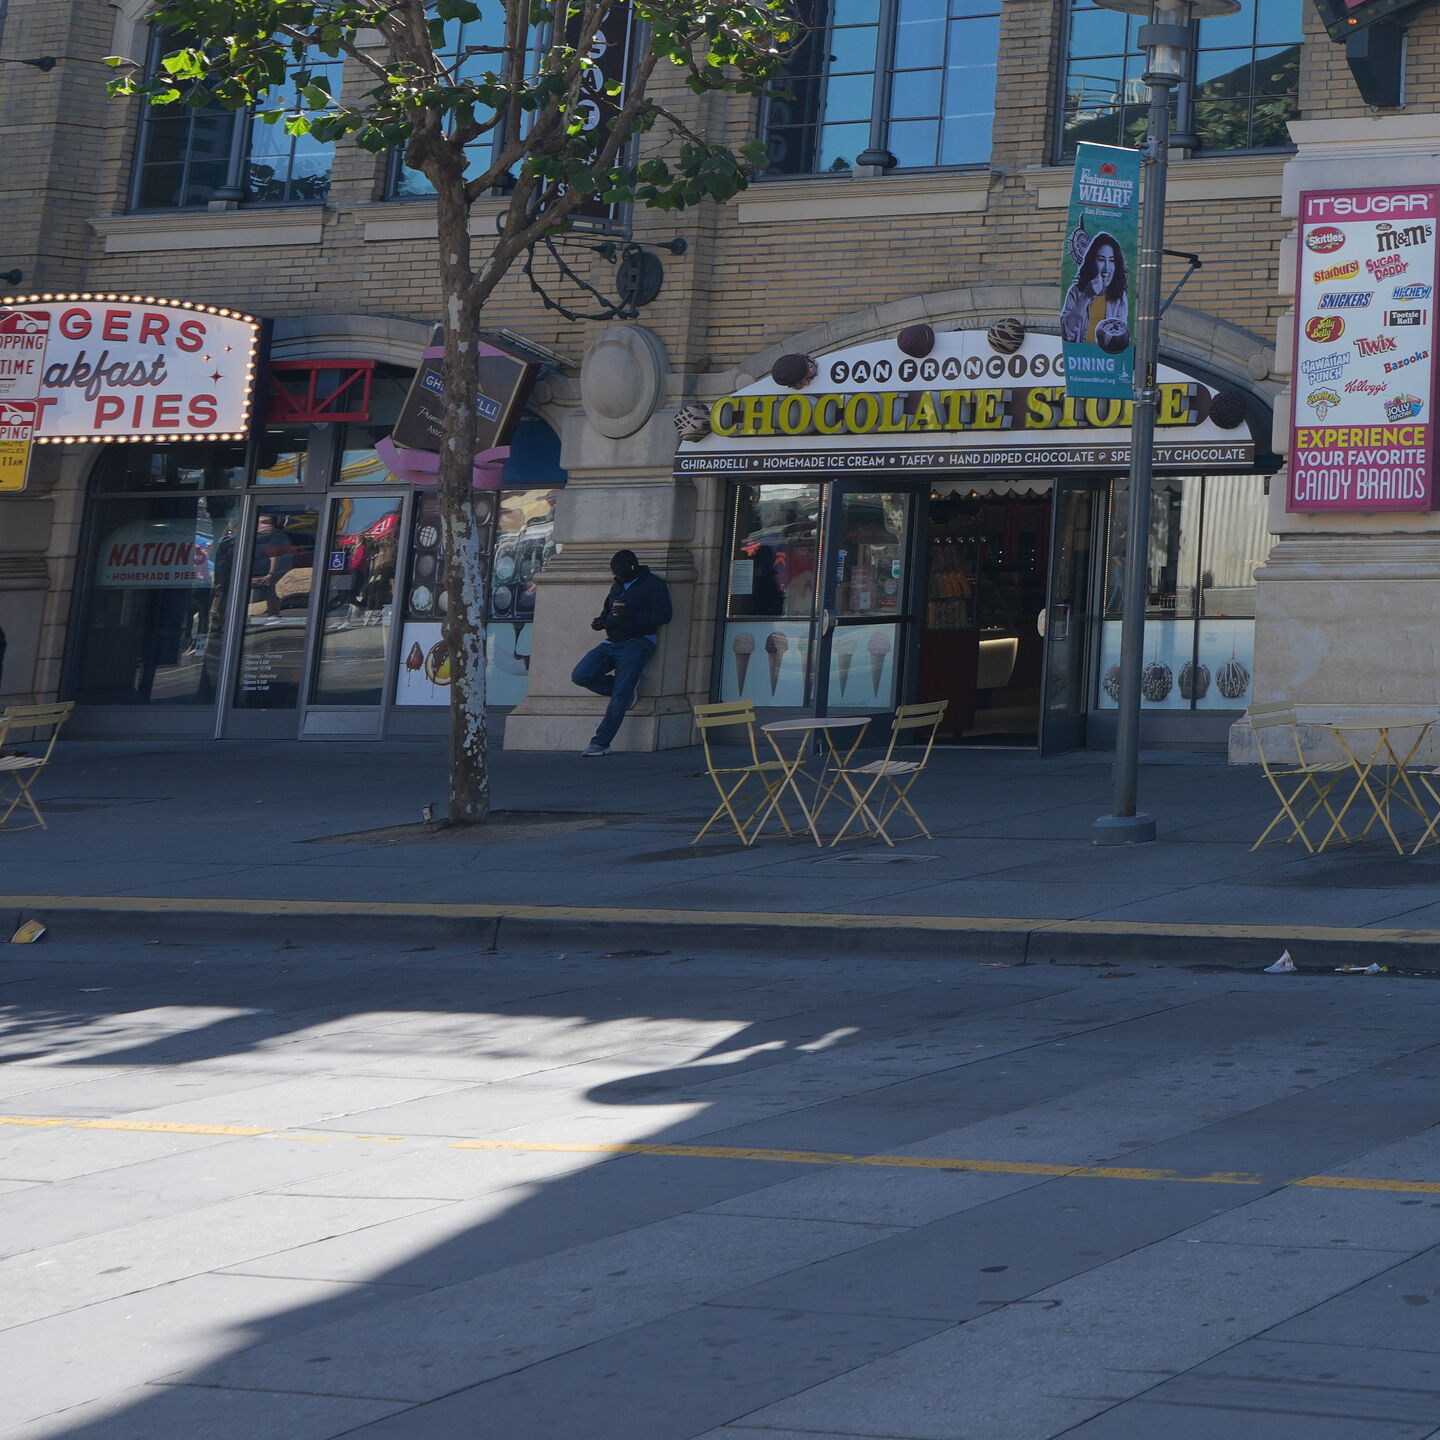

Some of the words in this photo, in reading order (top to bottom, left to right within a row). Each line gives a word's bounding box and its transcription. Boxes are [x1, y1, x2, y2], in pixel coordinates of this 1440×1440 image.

[1080, 168, 1133, 189] Fisherman's
[1079, 184, 1133, 208] WHARF
[1308, 194, 1428, 216] IT'SUGAR
[1309, 233, 1344, 247] Skittles
[1314, 260, 1359, 283] Starburst
[1374, 262, 1409, 282] DADDY
[1320, 294, 1371, 308] SNICKERS
[59, 308, 206, 352] GERS
[1311, 328, 1332, 338] Belly
[1318, 317, 1336, 329] Jelly
[833, 361, 891, 382] SAN
[900, 355, 1064, 381] FRANCISC
[1068, 356, 1115, 372] DINING
[1301, 352, 1350, 374] HAWAIIAN
[1384, 350, 1429, 373] Bazooka
[43, 350, 167, 401] akfast
[1308, 366, 1343, 386] PUNCH
[1345, 379, 1387, 395] Kellogg's
[93, 394, 218, 429] PIES
[710, 388, 1006, 437] CHOCOLATE
[1025, 383, 1191, 429] STOE
[1387, 402, 1410, 417] JOLLY
[1297, 427, 1425, 448] EXPERIENCE
[681, 458, 748, 470] GHIRARDELLI
[763, 457, 825, 468] HOMEMADE
[827, 456, 844, 467] ICE
[846, 456, 885, 468] CREAM
[900, 455, 934, 466] TAFFY
[950, 453, 980, 465] HAND
[983, 452, 1022, 464] DIPPED
[1025, 451, 1094, 463] CHOCOLATE
[1174, 449, 1245, 461] CHOCOLATE
[1298, 450, 1344, 466] YOUR
[1347, 449, 1425, 466] FAVORITE
[1295, 468, 1351, 501] CANDY
[1356, 468, 1426, 500] BRANDS
[112, 572, 169, 581] HOMEMADE
